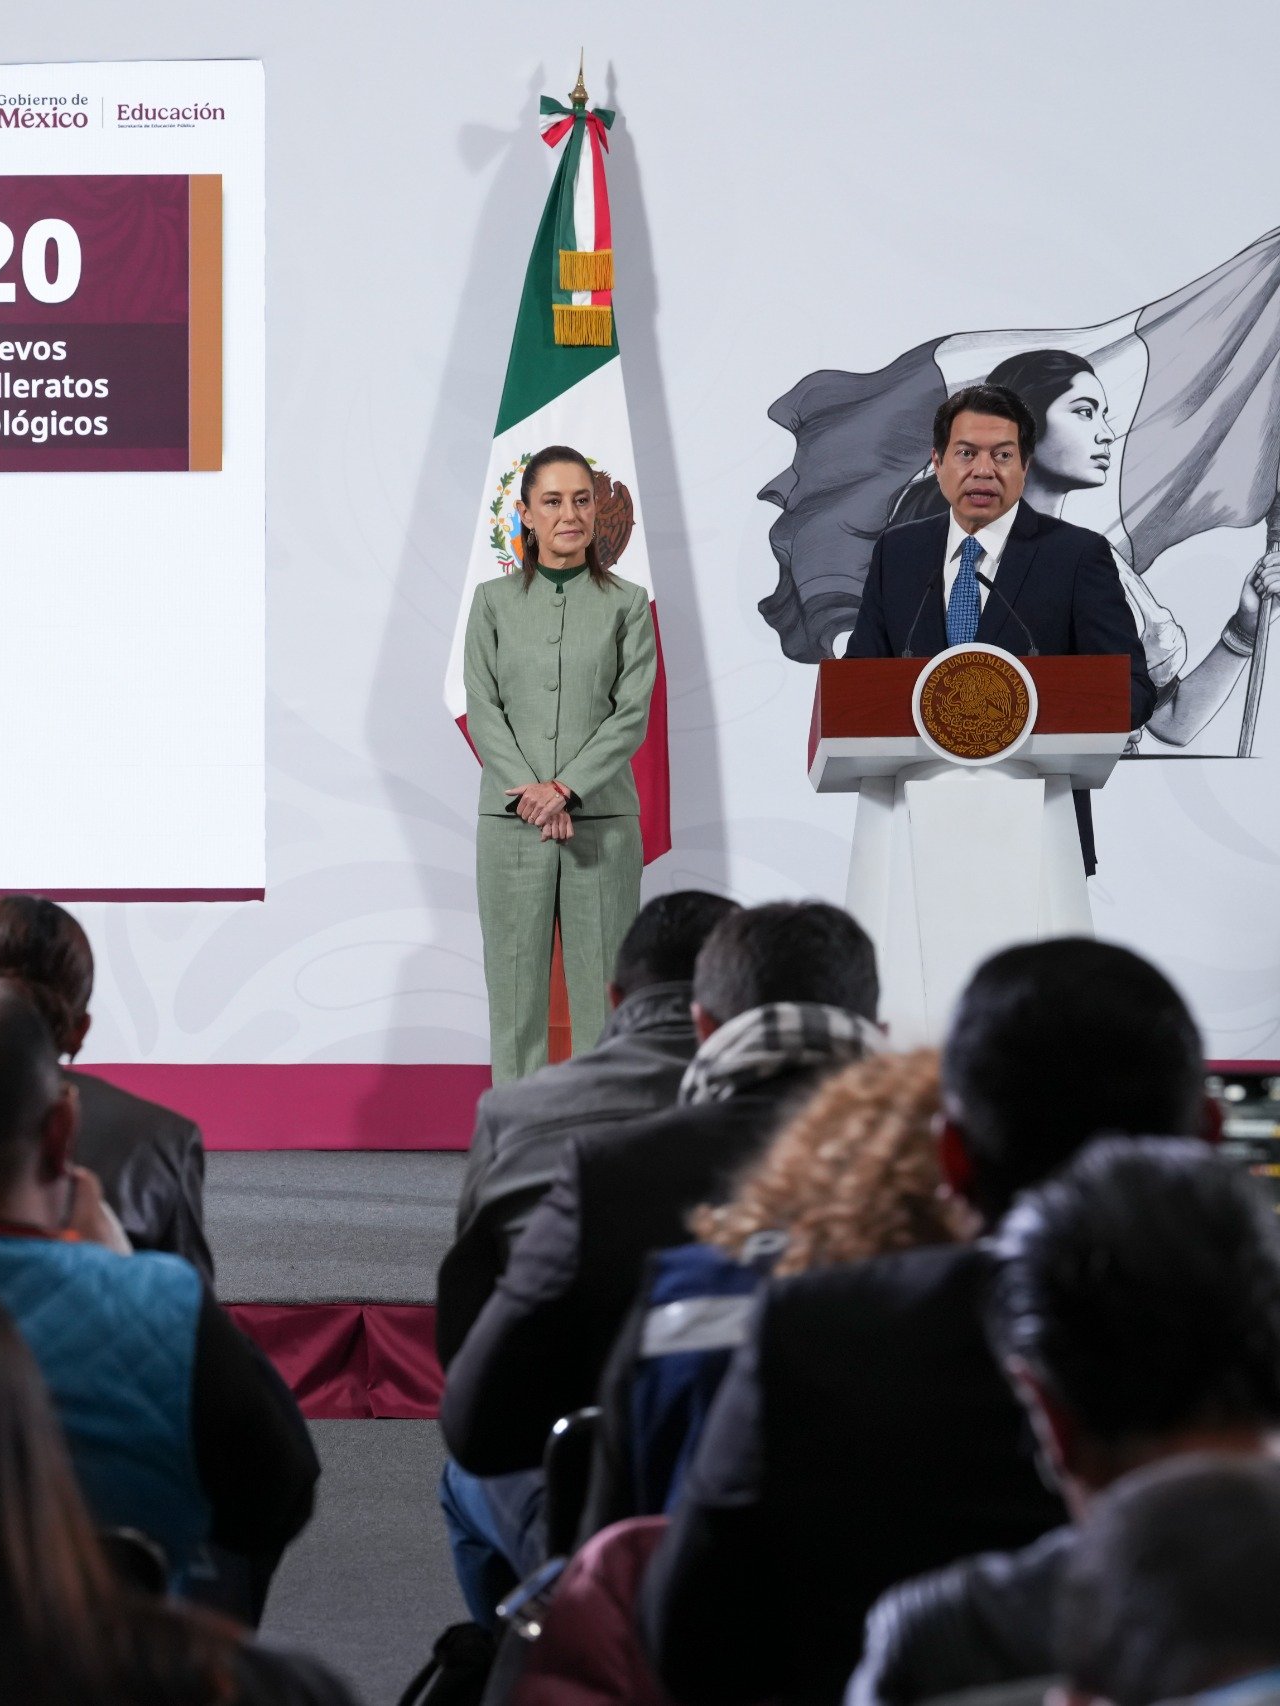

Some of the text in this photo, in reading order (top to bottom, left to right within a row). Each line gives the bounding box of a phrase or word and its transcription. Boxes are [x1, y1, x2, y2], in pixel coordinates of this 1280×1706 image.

[71, 93, 89, 106] de
[117, 102, 226, 121] Educación
[923, 654, 1027, 706] ESTADOS UNIDOS MEXICANOS
